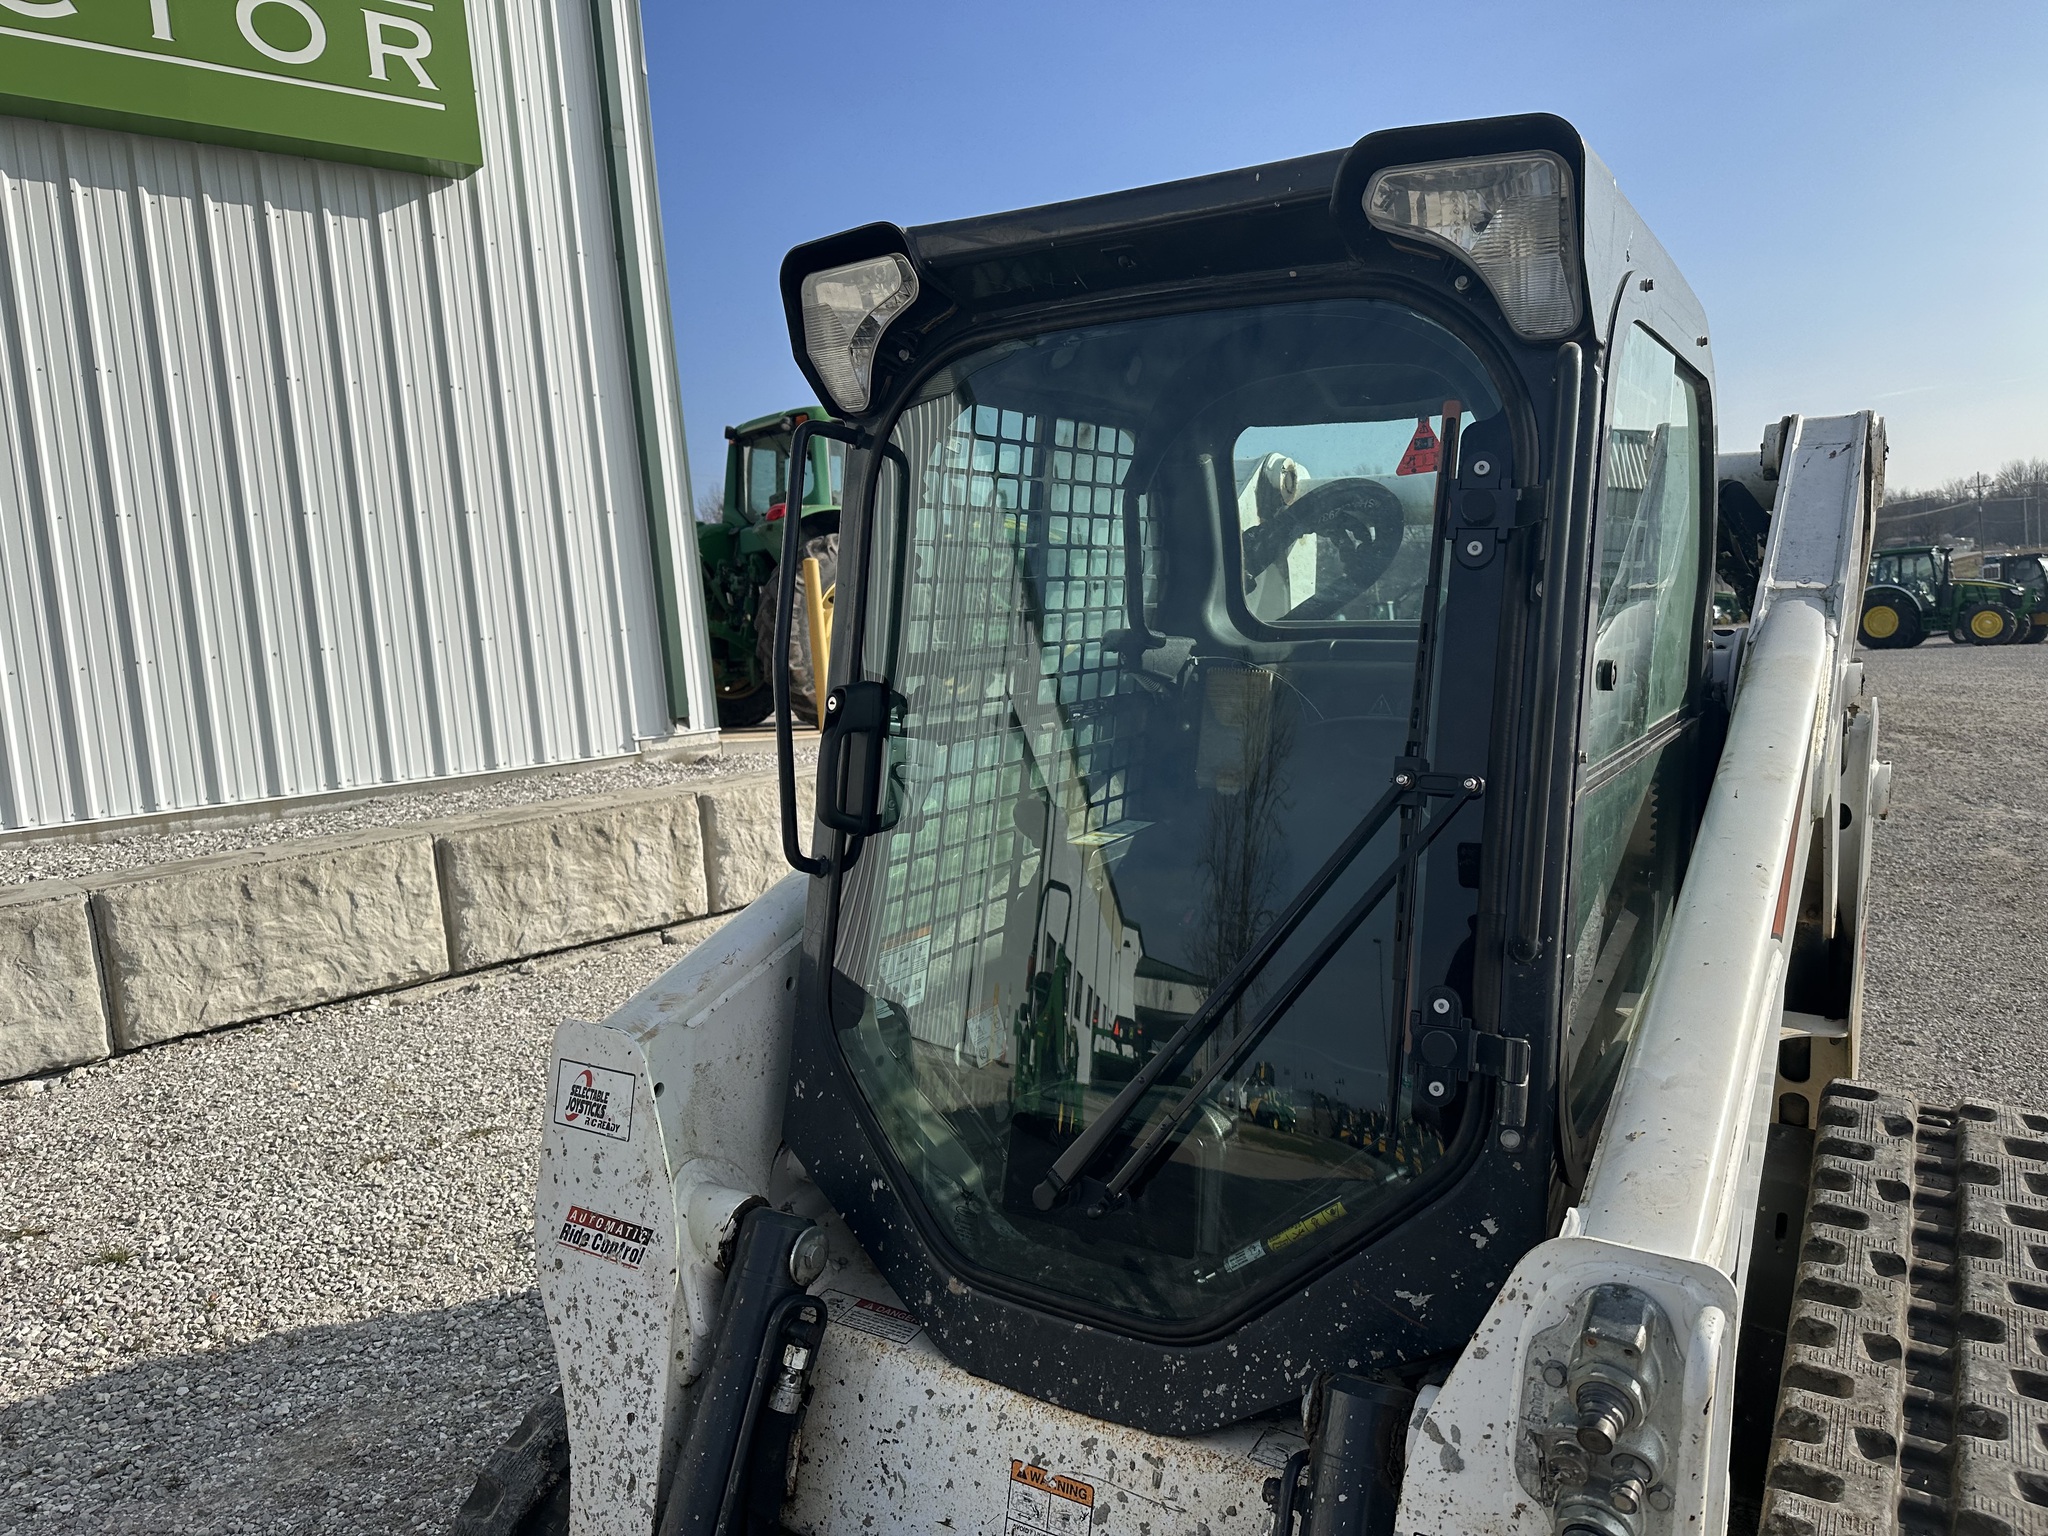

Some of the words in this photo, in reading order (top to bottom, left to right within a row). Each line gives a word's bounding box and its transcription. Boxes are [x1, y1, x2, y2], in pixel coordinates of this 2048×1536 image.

[0, 0, 441, 91] OR
[565, 1096, 607, 1119] JOYSTICKS
[570, 1084, 610, 1104] SELECTABLE
[596, 1119, 621, 1133] READY
[569, 1209, 648, 1243] AUTOMATIC
[559, 1222, 591, 1248] Ride
[591, 1232, 646, 1265] Control
[1029, 1470, 1087, 1500] WNING
